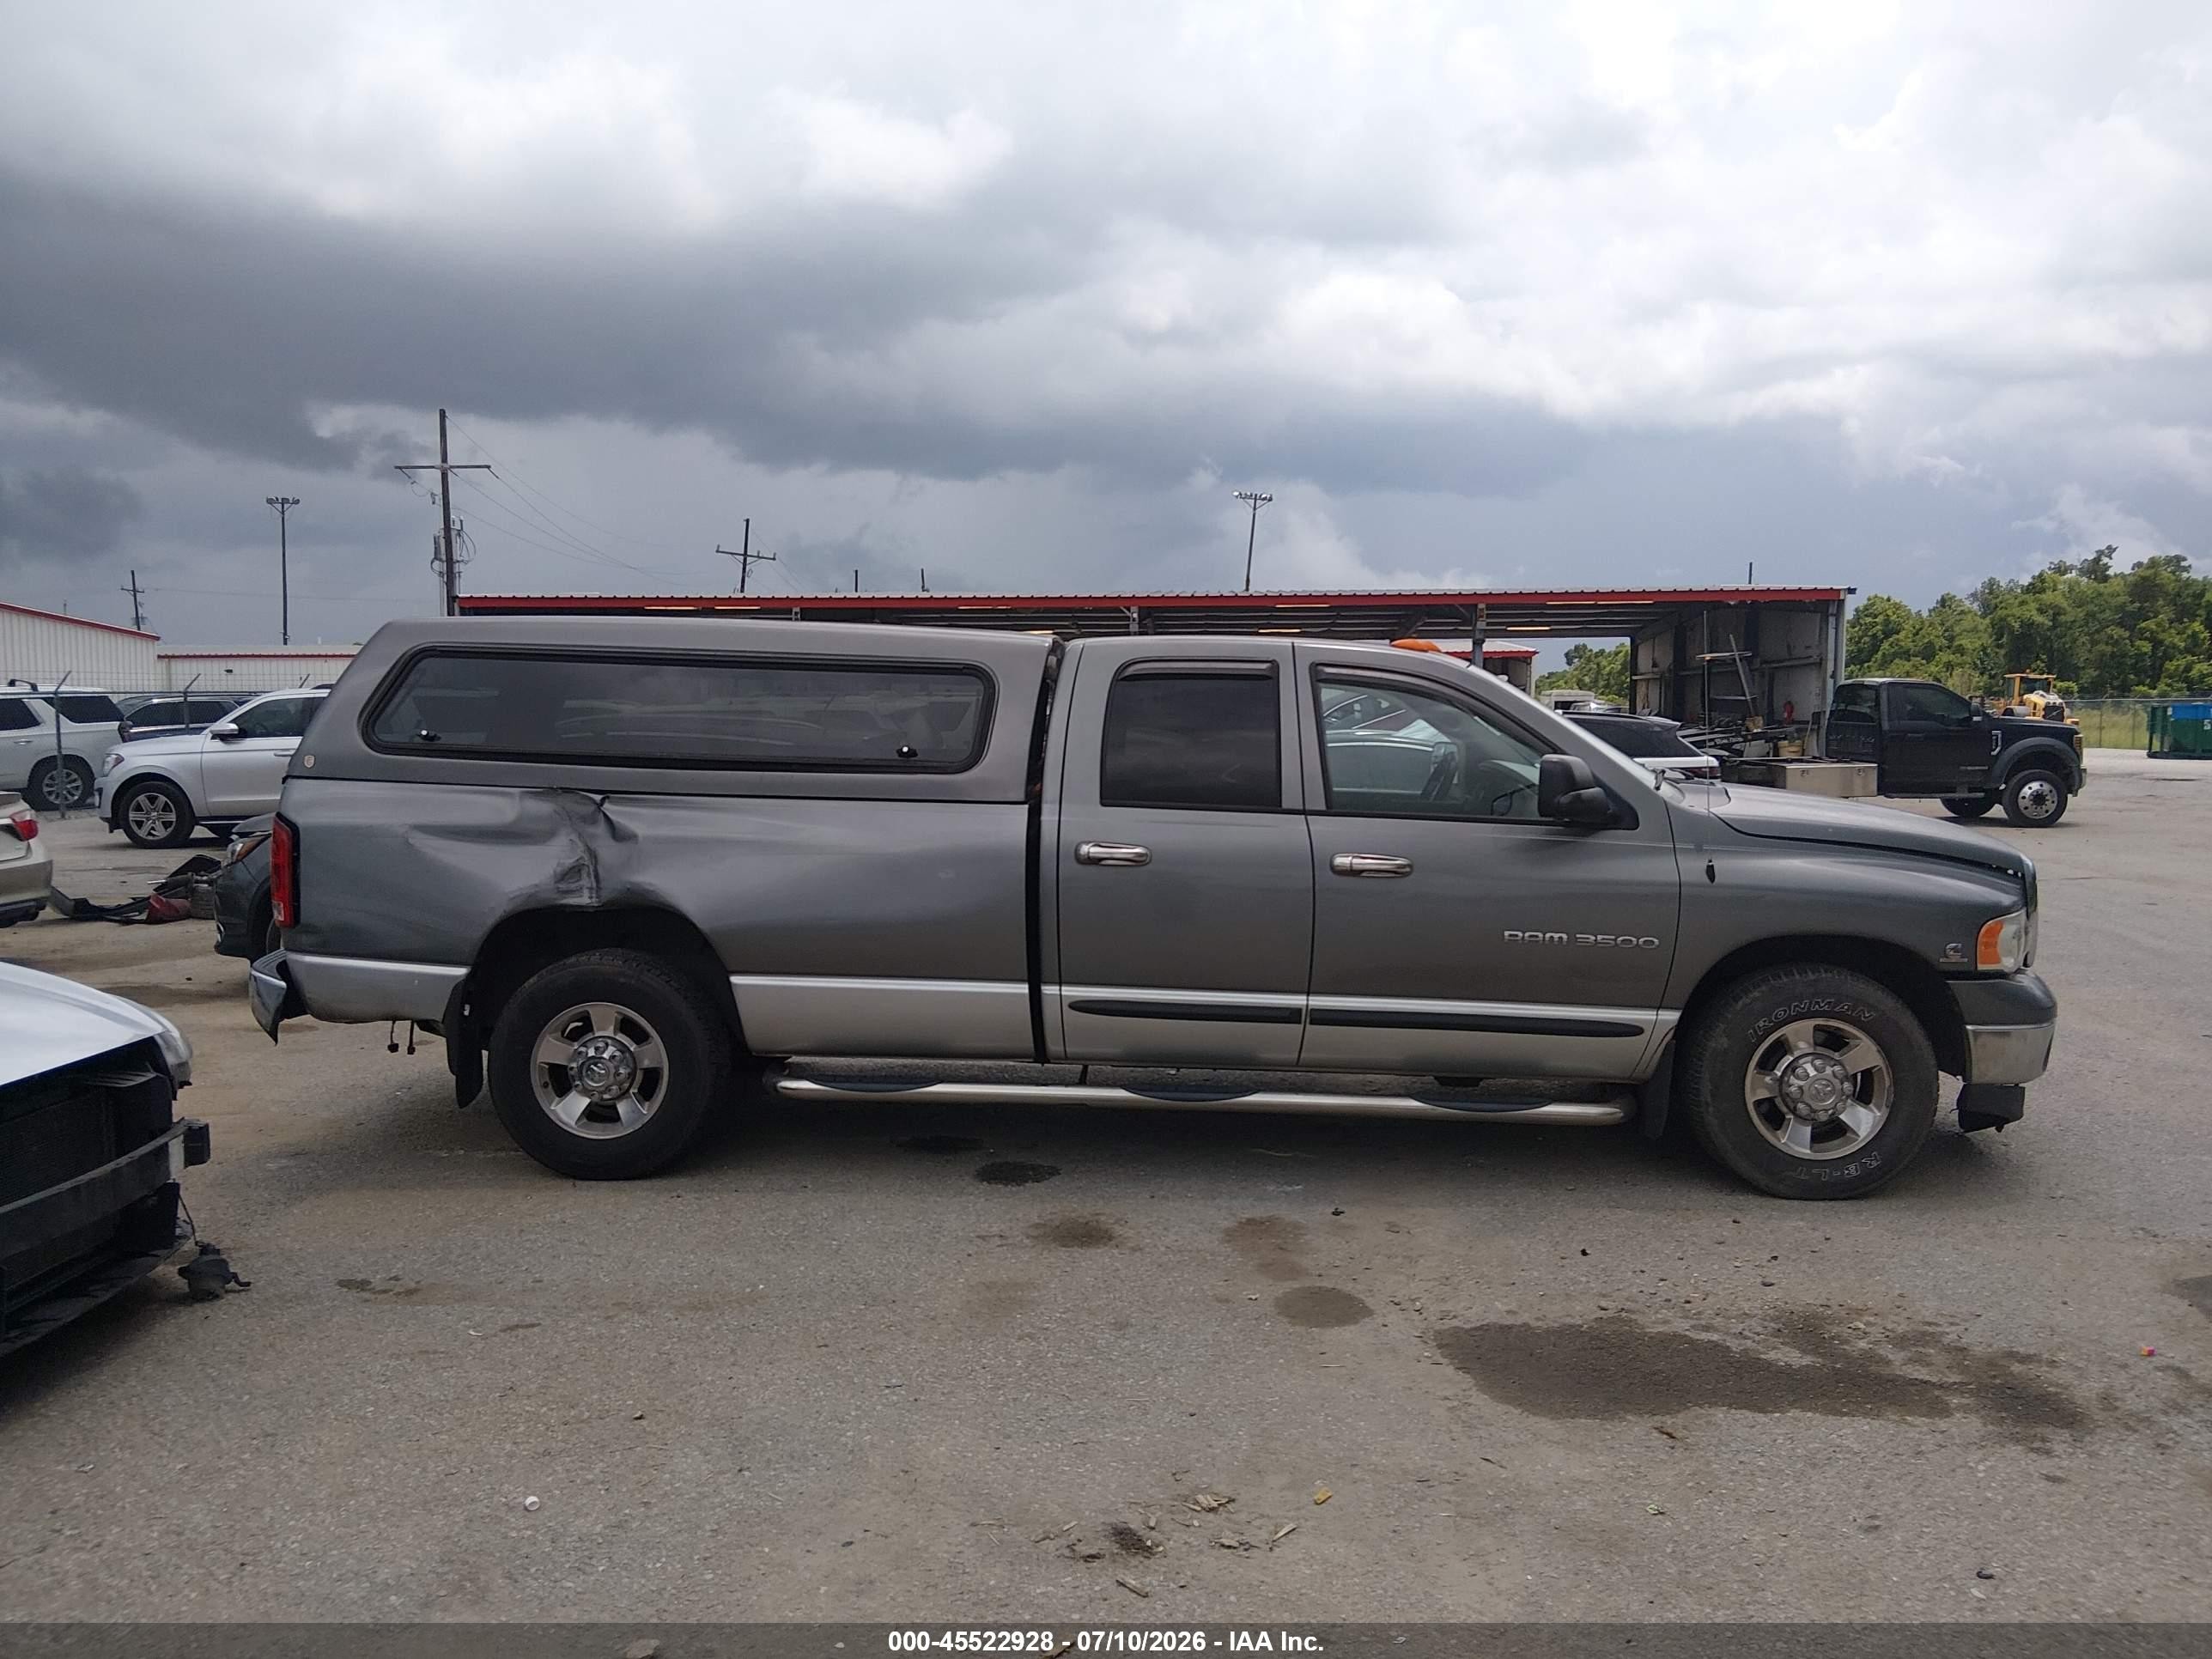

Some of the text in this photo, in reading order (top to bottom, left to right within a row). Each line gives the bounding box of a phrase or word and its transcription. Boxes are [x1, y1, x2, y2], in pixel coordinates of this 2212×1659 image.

[1504, 930, 1660, 949] RAM 3500
[1747, 998, 1875, 1042] IRONMAN
